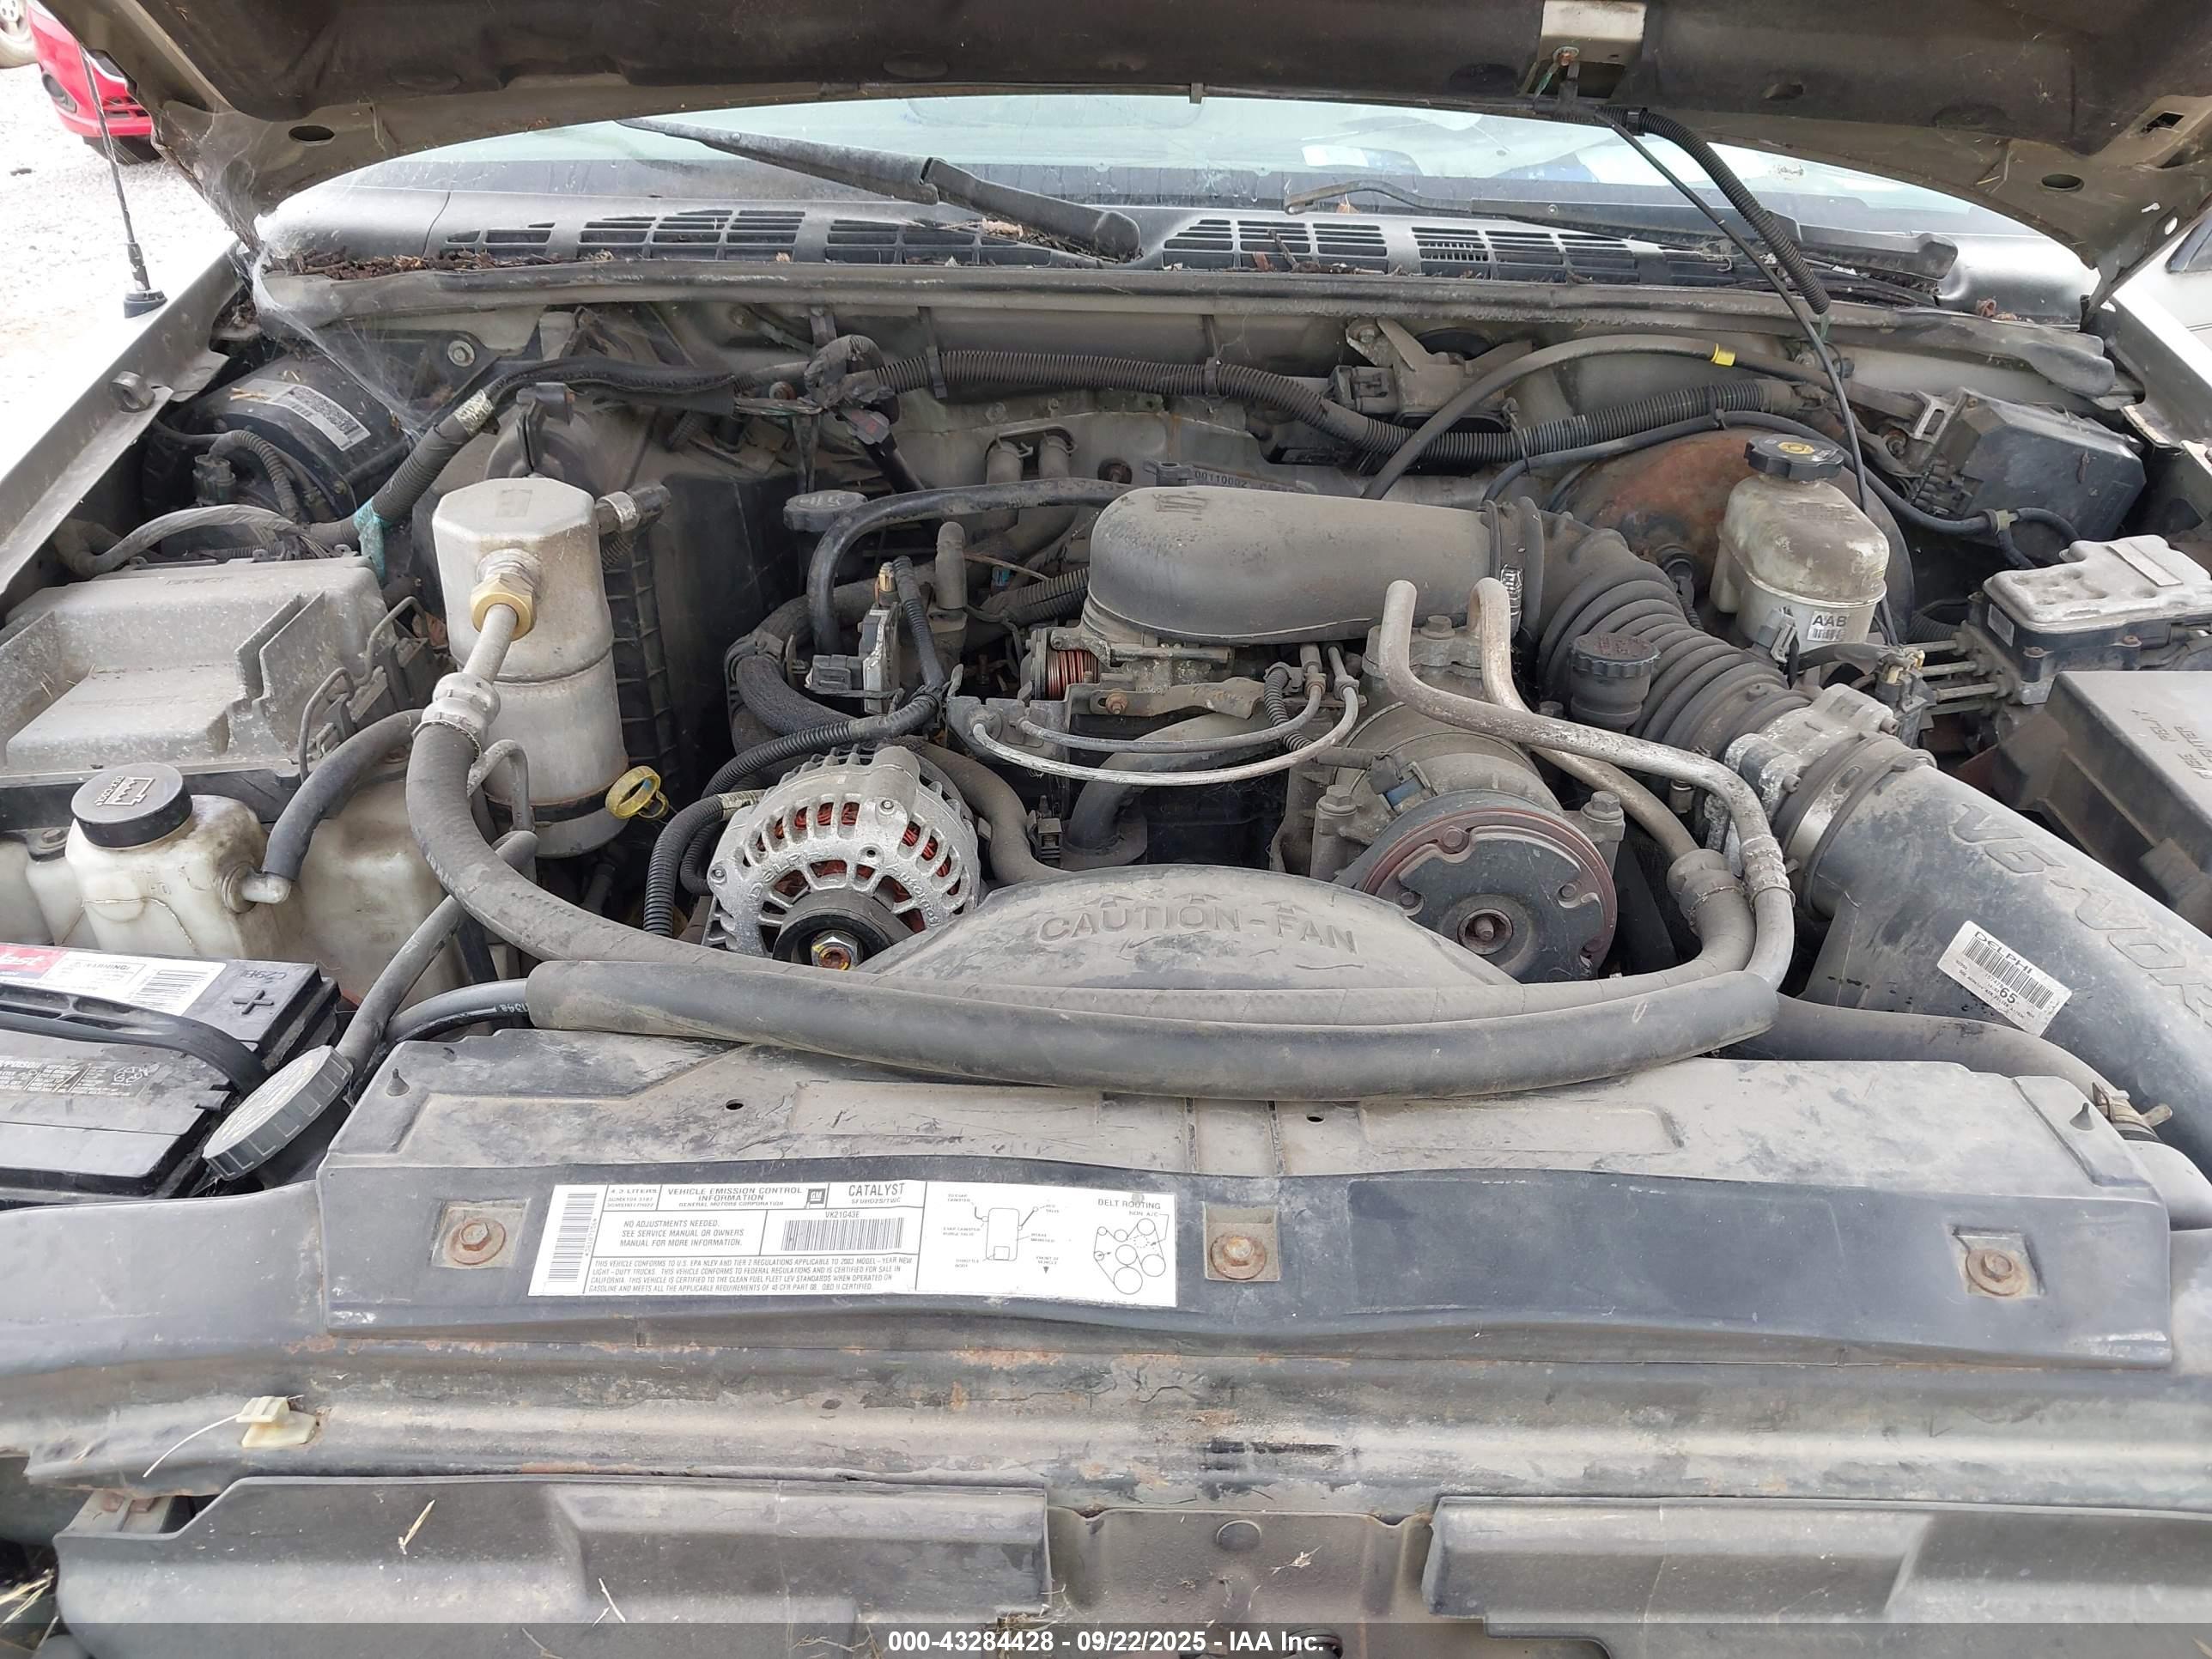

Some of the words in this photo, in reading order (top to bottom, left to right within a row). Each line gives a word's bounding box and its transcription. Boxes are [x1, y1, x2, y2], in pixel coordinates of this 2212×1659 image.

[1812, 615, 1848, 627] AAB
[1974, 931, 2033, 975] DELPHI
[848, 1182, 905, 1197] CATALYST
[1097, 1198, 1120, 1207] BELT
[1121, 1200, 1161, 1210] ROUTING
[635, 1219, 687, 1228] ADJUSTMENTS
[669, 1229, 698, 1237] MANUAL
